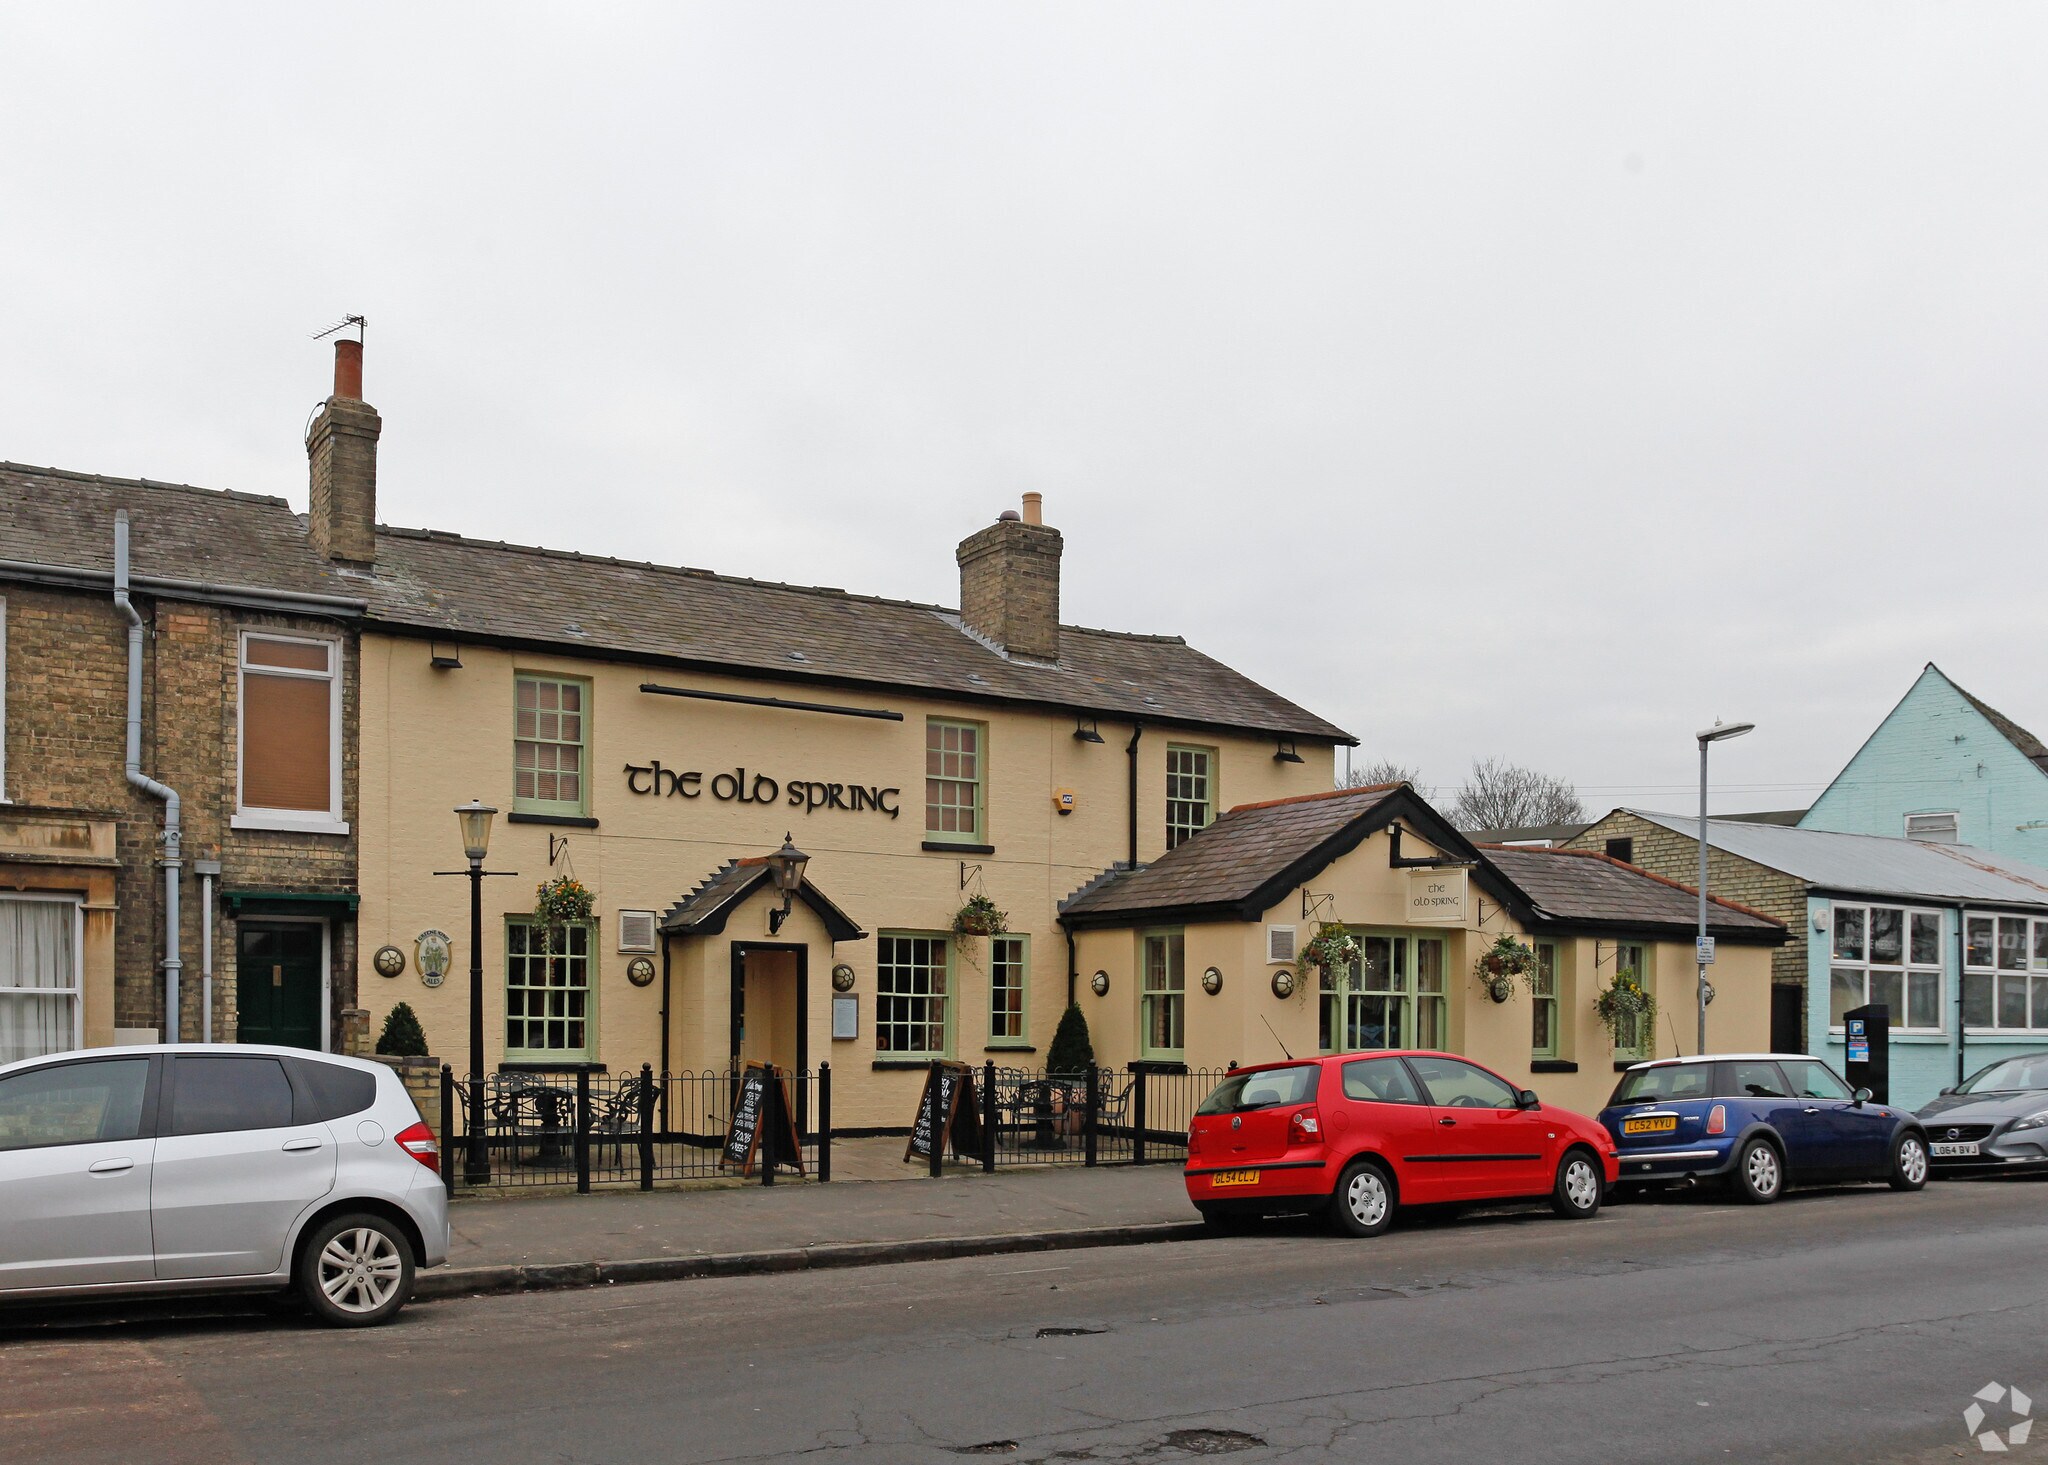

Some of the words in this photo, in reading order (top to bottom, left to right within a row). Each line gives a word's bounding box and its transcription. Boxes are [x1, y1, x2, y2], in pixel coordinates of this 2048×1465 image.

[786, 780, 900, 820] SPRING
[1431, 896, 1459, 906] SPRING
[418, 930, 437, 941] GREENE
[438, 931, 450, 941] KING
[426, 977, 440, 985] ALES
[1852, 1022, 1862, 1033] P
[1628, 1120, 1651, 1131] LC52
[1653, 1118, 1672, 1129] YYU
[1934, 1146, 1957, 1155] LO64
[1958, 1145, 1977, 1154] BVJ
[1215, 1171, 1237, 1184] GL54
[1238, 1170, 1257, 1182] CLJ
